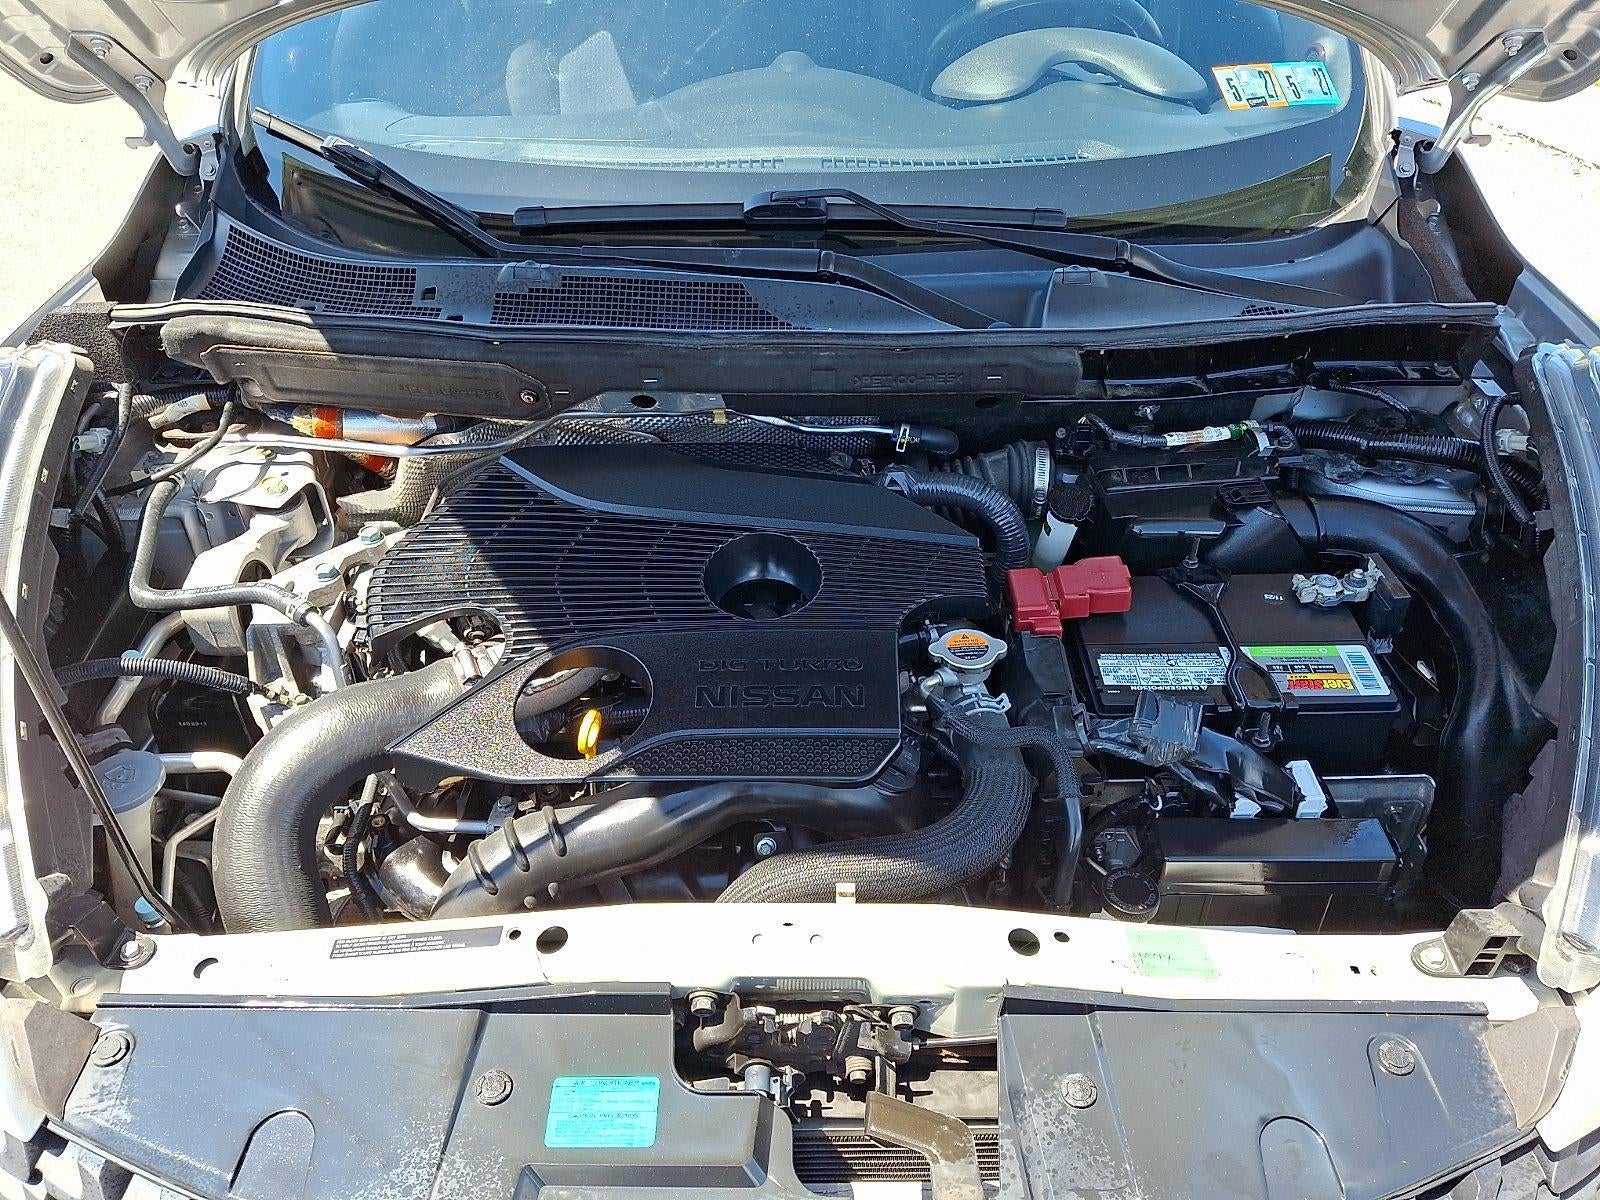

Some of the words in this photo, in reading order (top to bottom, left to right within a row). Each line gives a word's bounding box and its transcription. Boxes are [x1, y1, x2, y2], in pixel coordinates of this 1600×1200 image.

[1225, 77, 1242, 102] 5
[1285, 75, 1302, 100] 5
[698, 658, 748, 672] DIG
[755, 658, 864, 672] TURBO
[1287, 679, 1354, 690] EverStart
[694, 685, 867, 708] NISSAN
